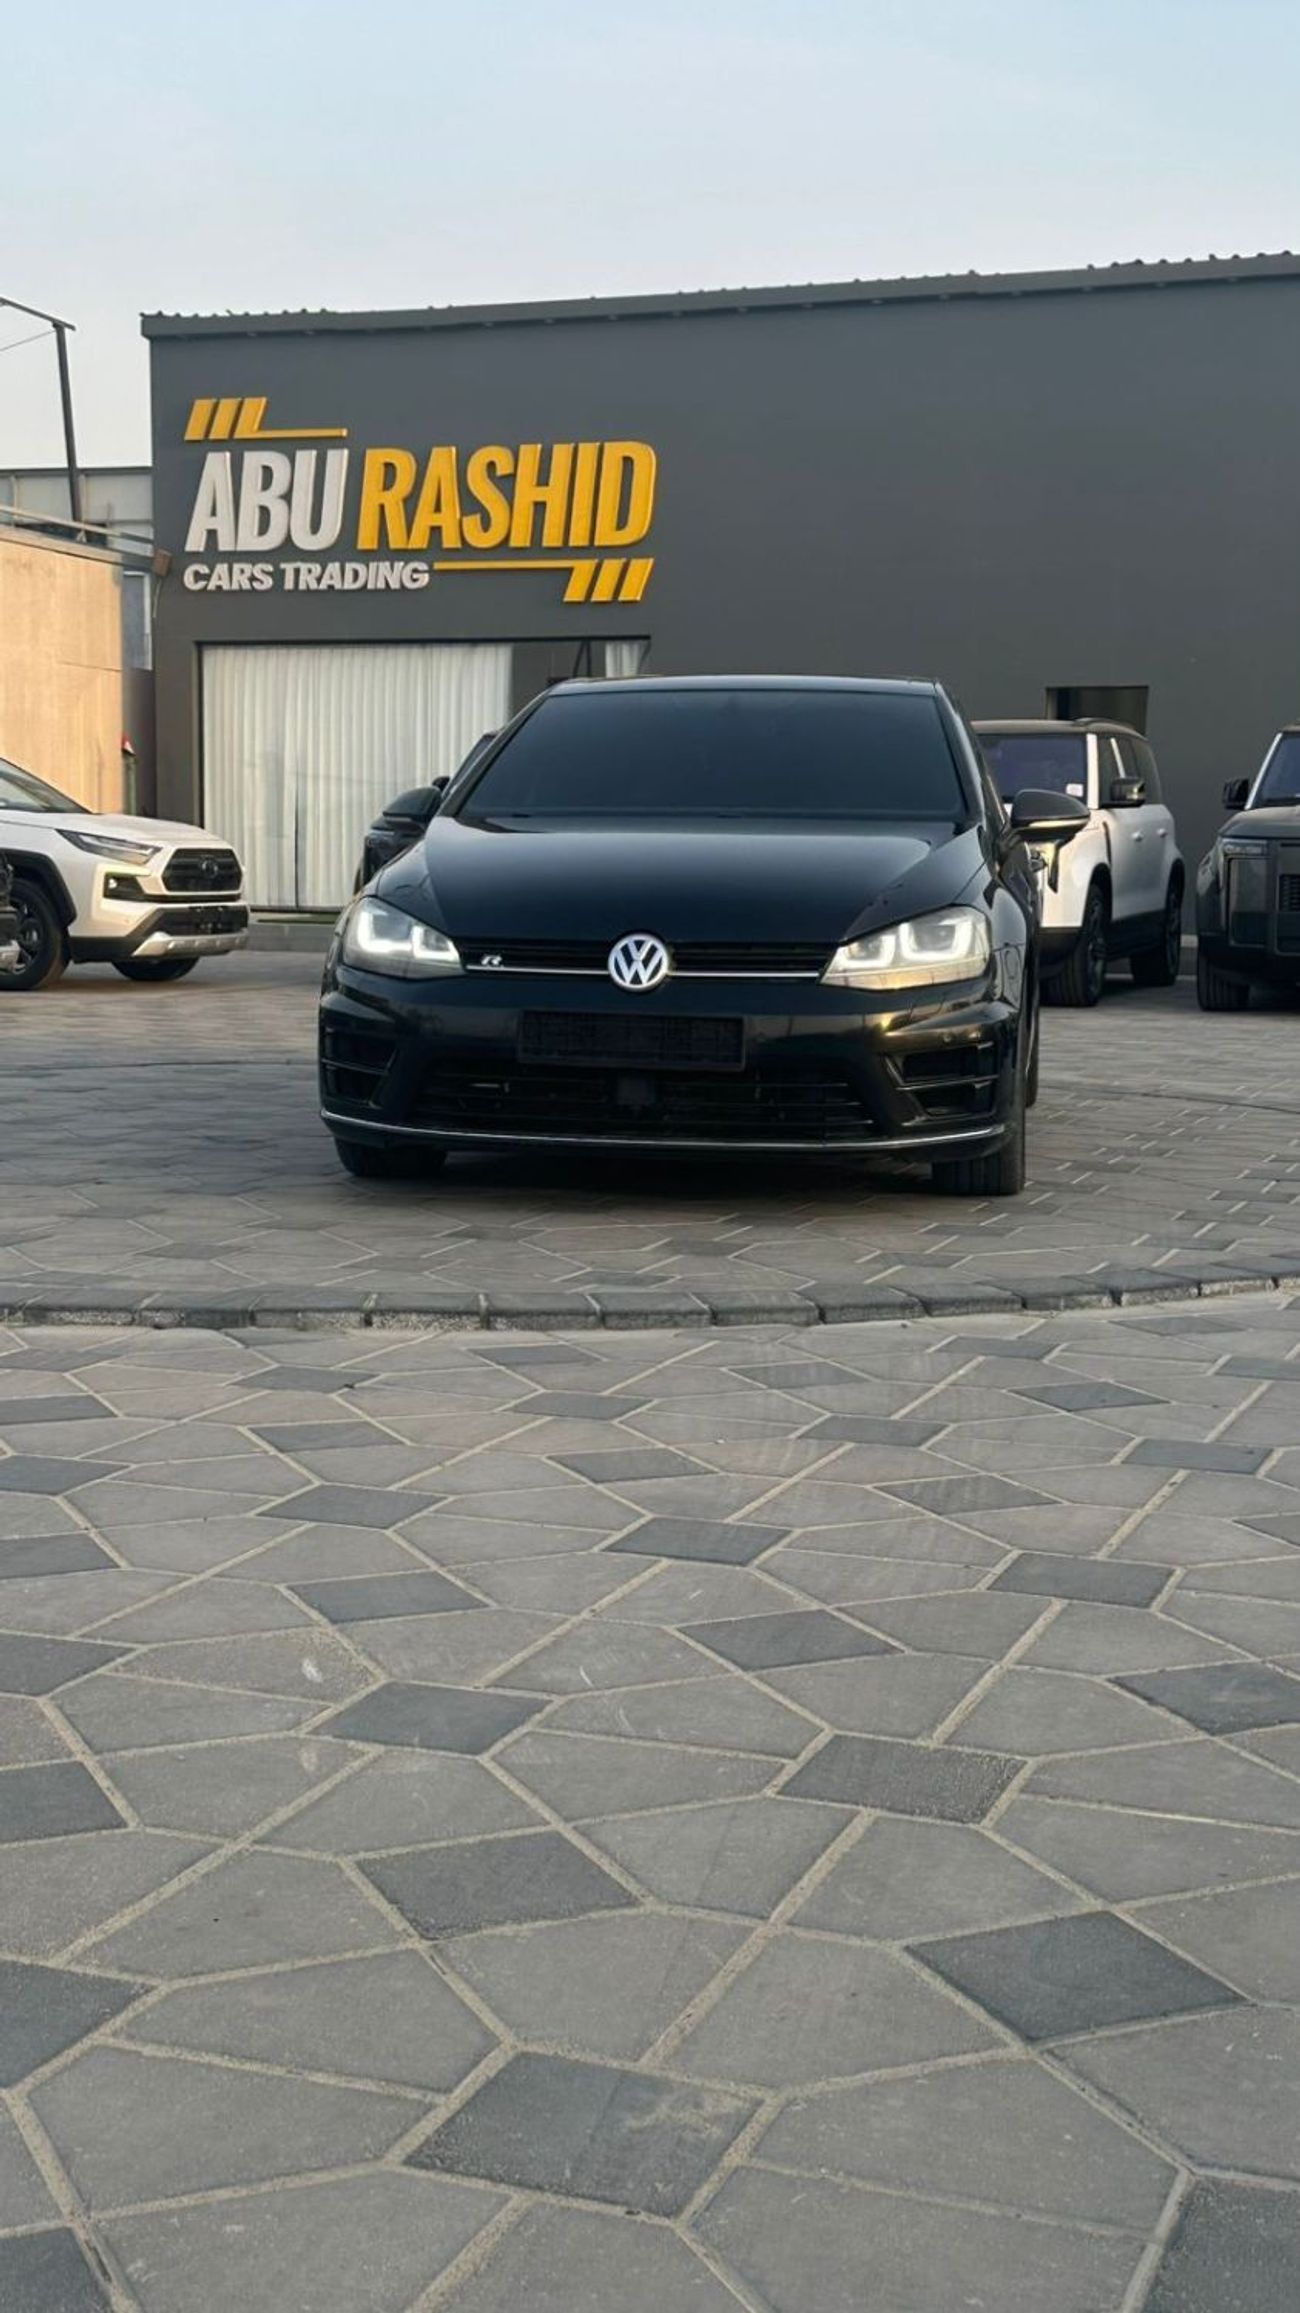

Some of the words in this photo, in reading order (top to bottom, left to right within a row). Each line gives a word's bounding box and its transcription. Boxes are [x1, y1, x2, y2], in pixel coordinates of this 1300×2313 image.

[184, 448, 349, 552] ABU
[356, 440, 657, 551] RASHID
[183, 562, 274, 592] CARS
[280, 561, 430, 591] TRADING
[480, 954, 503, 967] R
